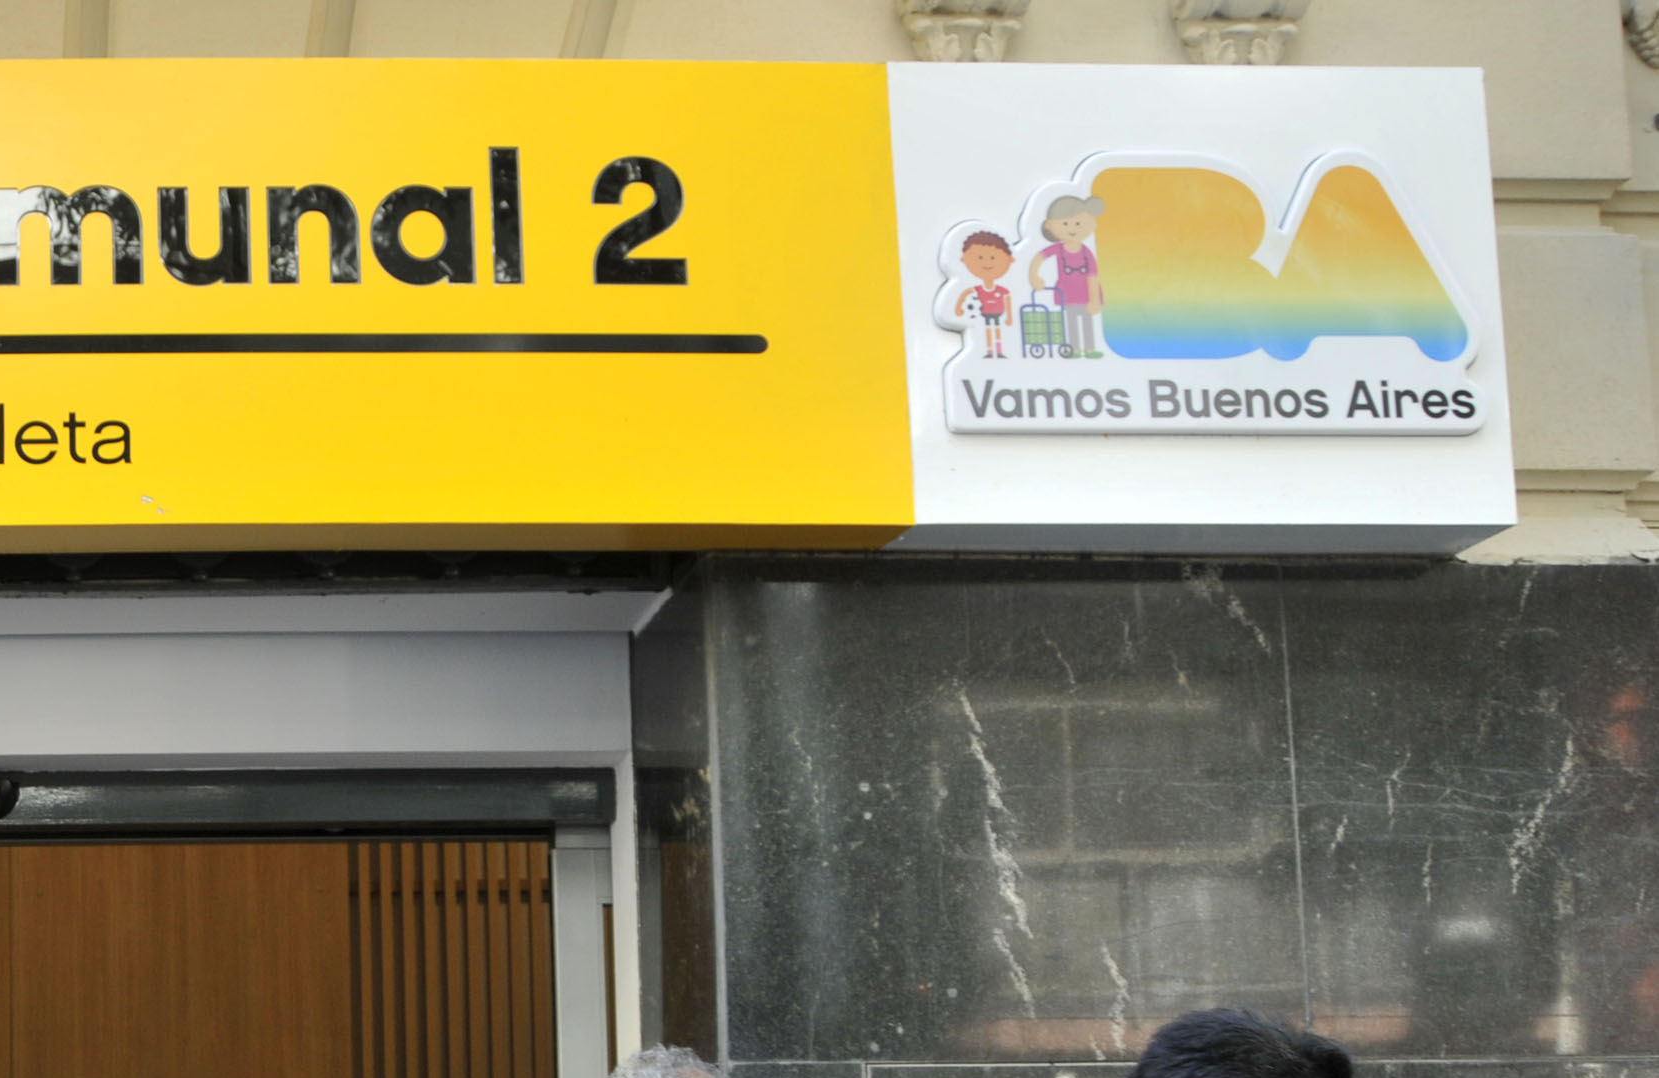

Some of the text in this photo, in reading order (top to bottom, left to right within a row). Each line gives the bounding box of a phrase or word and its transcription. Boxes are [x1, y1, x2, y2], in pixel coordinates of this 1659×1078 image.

[591, 155, 688, 287] 2
[961, 379, 1476, 420] Vamos Buenos Aires
